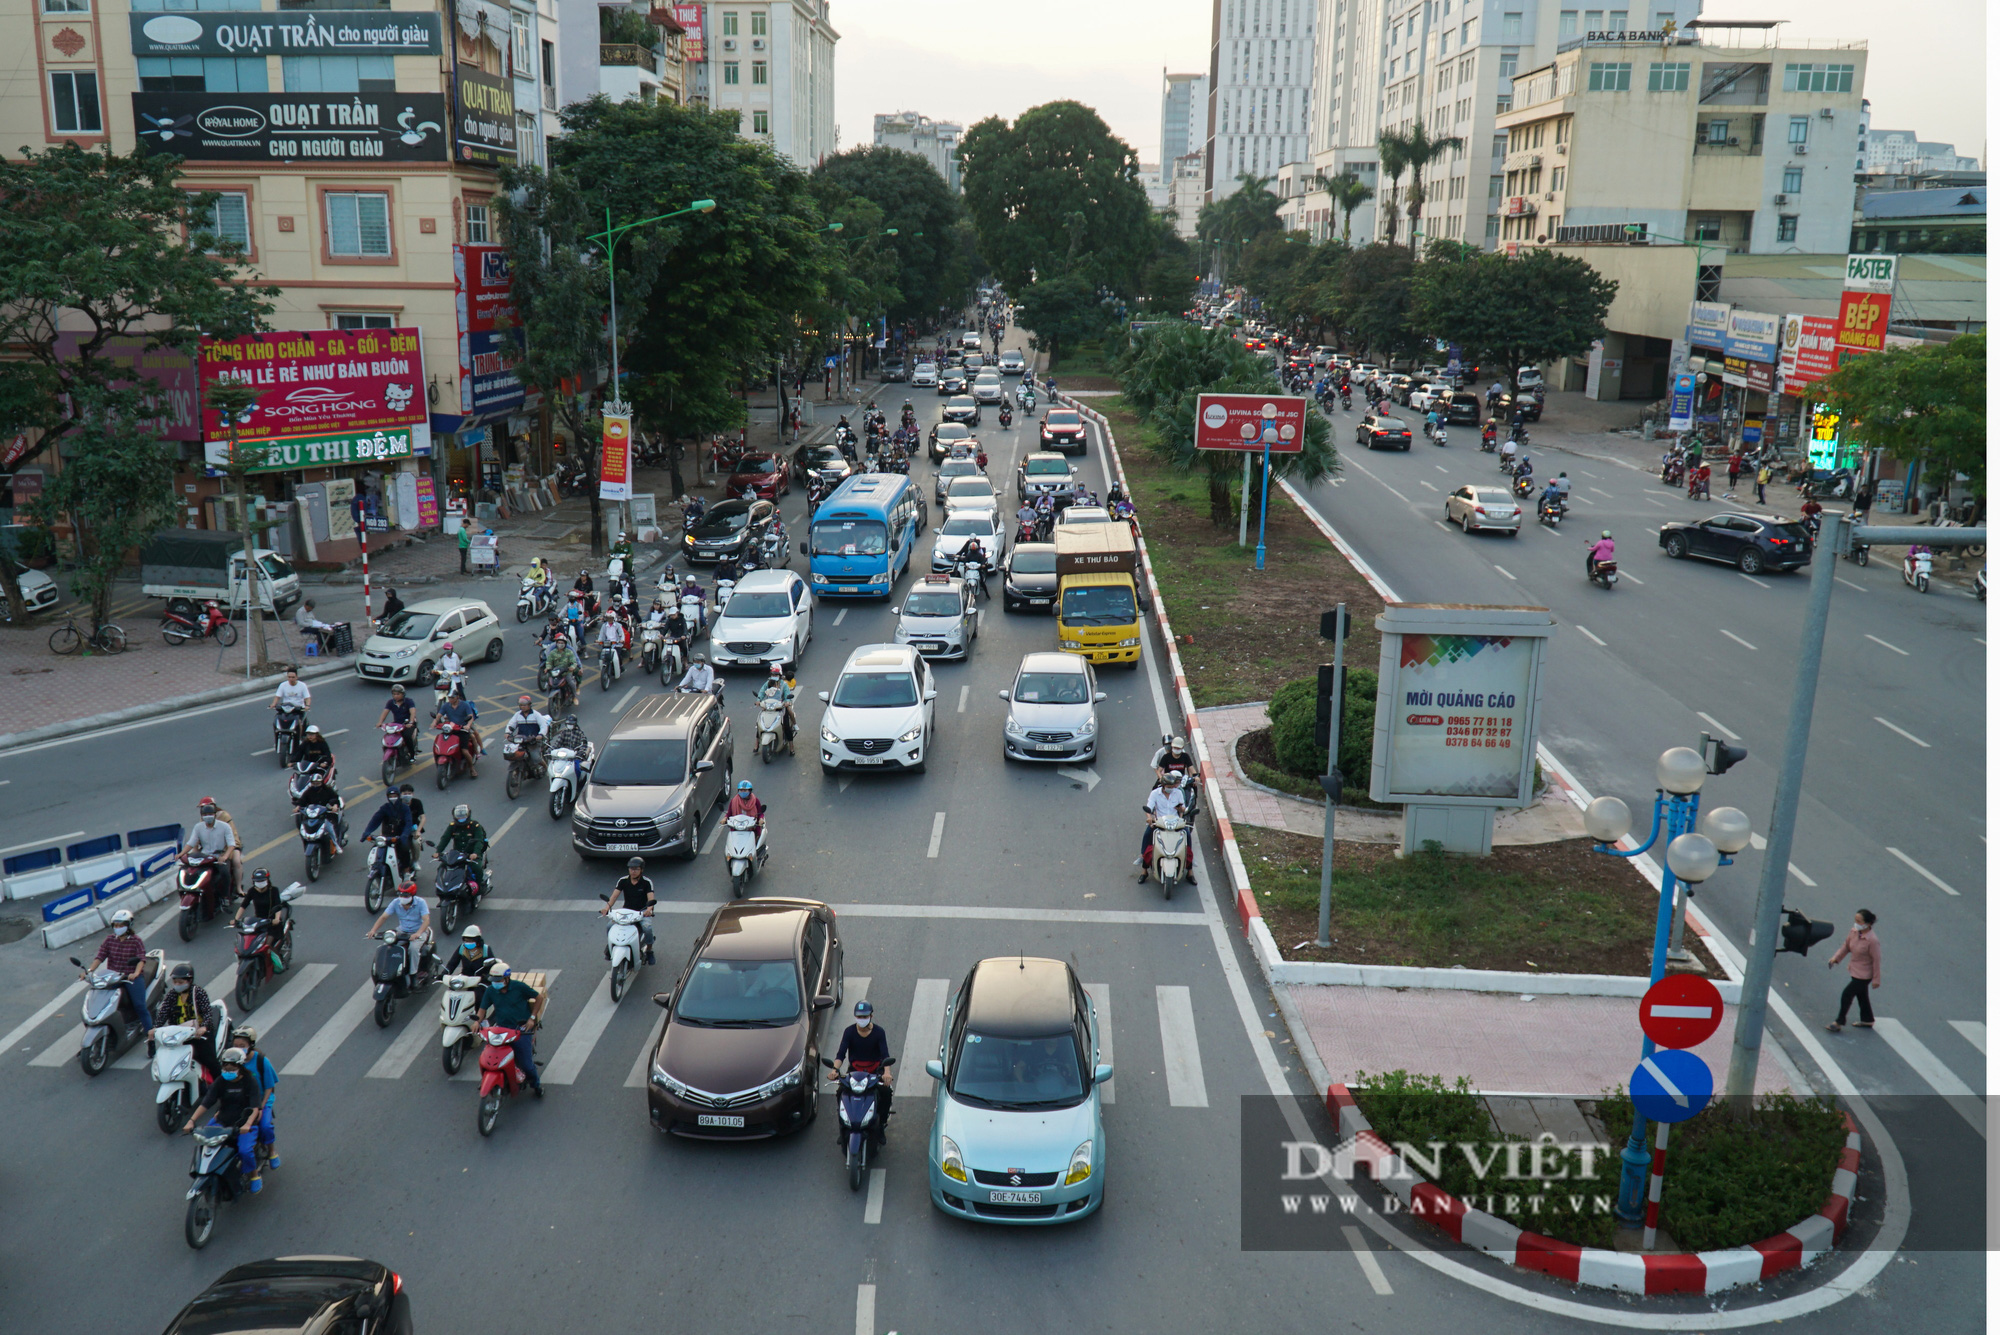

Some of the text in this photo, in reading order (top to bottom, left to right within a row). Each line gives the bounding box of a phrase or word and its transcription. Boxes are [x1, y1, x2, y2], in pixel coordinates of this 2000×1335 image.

[216, 14, 429, 53] QUẠT TRẦN cho người giàu
[1588, 31, 1667, 41] BAC A BANK
[462, 80, 488, 116] QUẠT
[233, 117, 259, 128] HOME
[269, 96, 379, 130] QUẠT TRẦN
[464, 114, 478, 136] cho
[202, 139, 261, 147] WWW.QUATTRAN.VN
[269, 137, 383, 157] CHO NGƯỜI GIÀU
[1848, 258, 1893, 280] FASTER
[1845, 294, 1880, 331] BẾP
[246, 342, 274, 361] KHO
[279, 337, 315, 359] CHĂN
[327, 339, 346, 356] GA
[358, 332, 379, 354] GỐI
[390, 333, 417, 356] ĐỆM
[1839, 329, 1880, 348] HOÀNG GIA
[256, 361, 275, 384] LẺ
[279, 360, 299, 382] RẺ
[303, 361, 336, 381] NHƯ
[338, 357, 368, 379] BÁN
[371, 357, 409, 377] BUÔN
[264, 399, 376, 417] SONG HONG
[305, 440, 350, 462] THỊ
[356, 431, 408, 460] ĐỆM
[1086, 555, 1101, 564] THƯ
[1103, 555, 1119, 563] BÁO
[1406, 689, 1515, 708] MỜI QUẢNG CÁO
[1448, 716, 1470, 725] 0965
[1473, 716, 1484, 726] 77
[1486, 717, 1497, 726] 81
[1501, 717, 1512, 727] 18
[1446, 727, 1512, 737] 0346 07 32 87
[1445, 737, 1511, 748] 0378 64 66 49
[699, 1116, 743, 1126] 89A-101.05
[991, 1192, 1040, 1203] 30E-744.56
